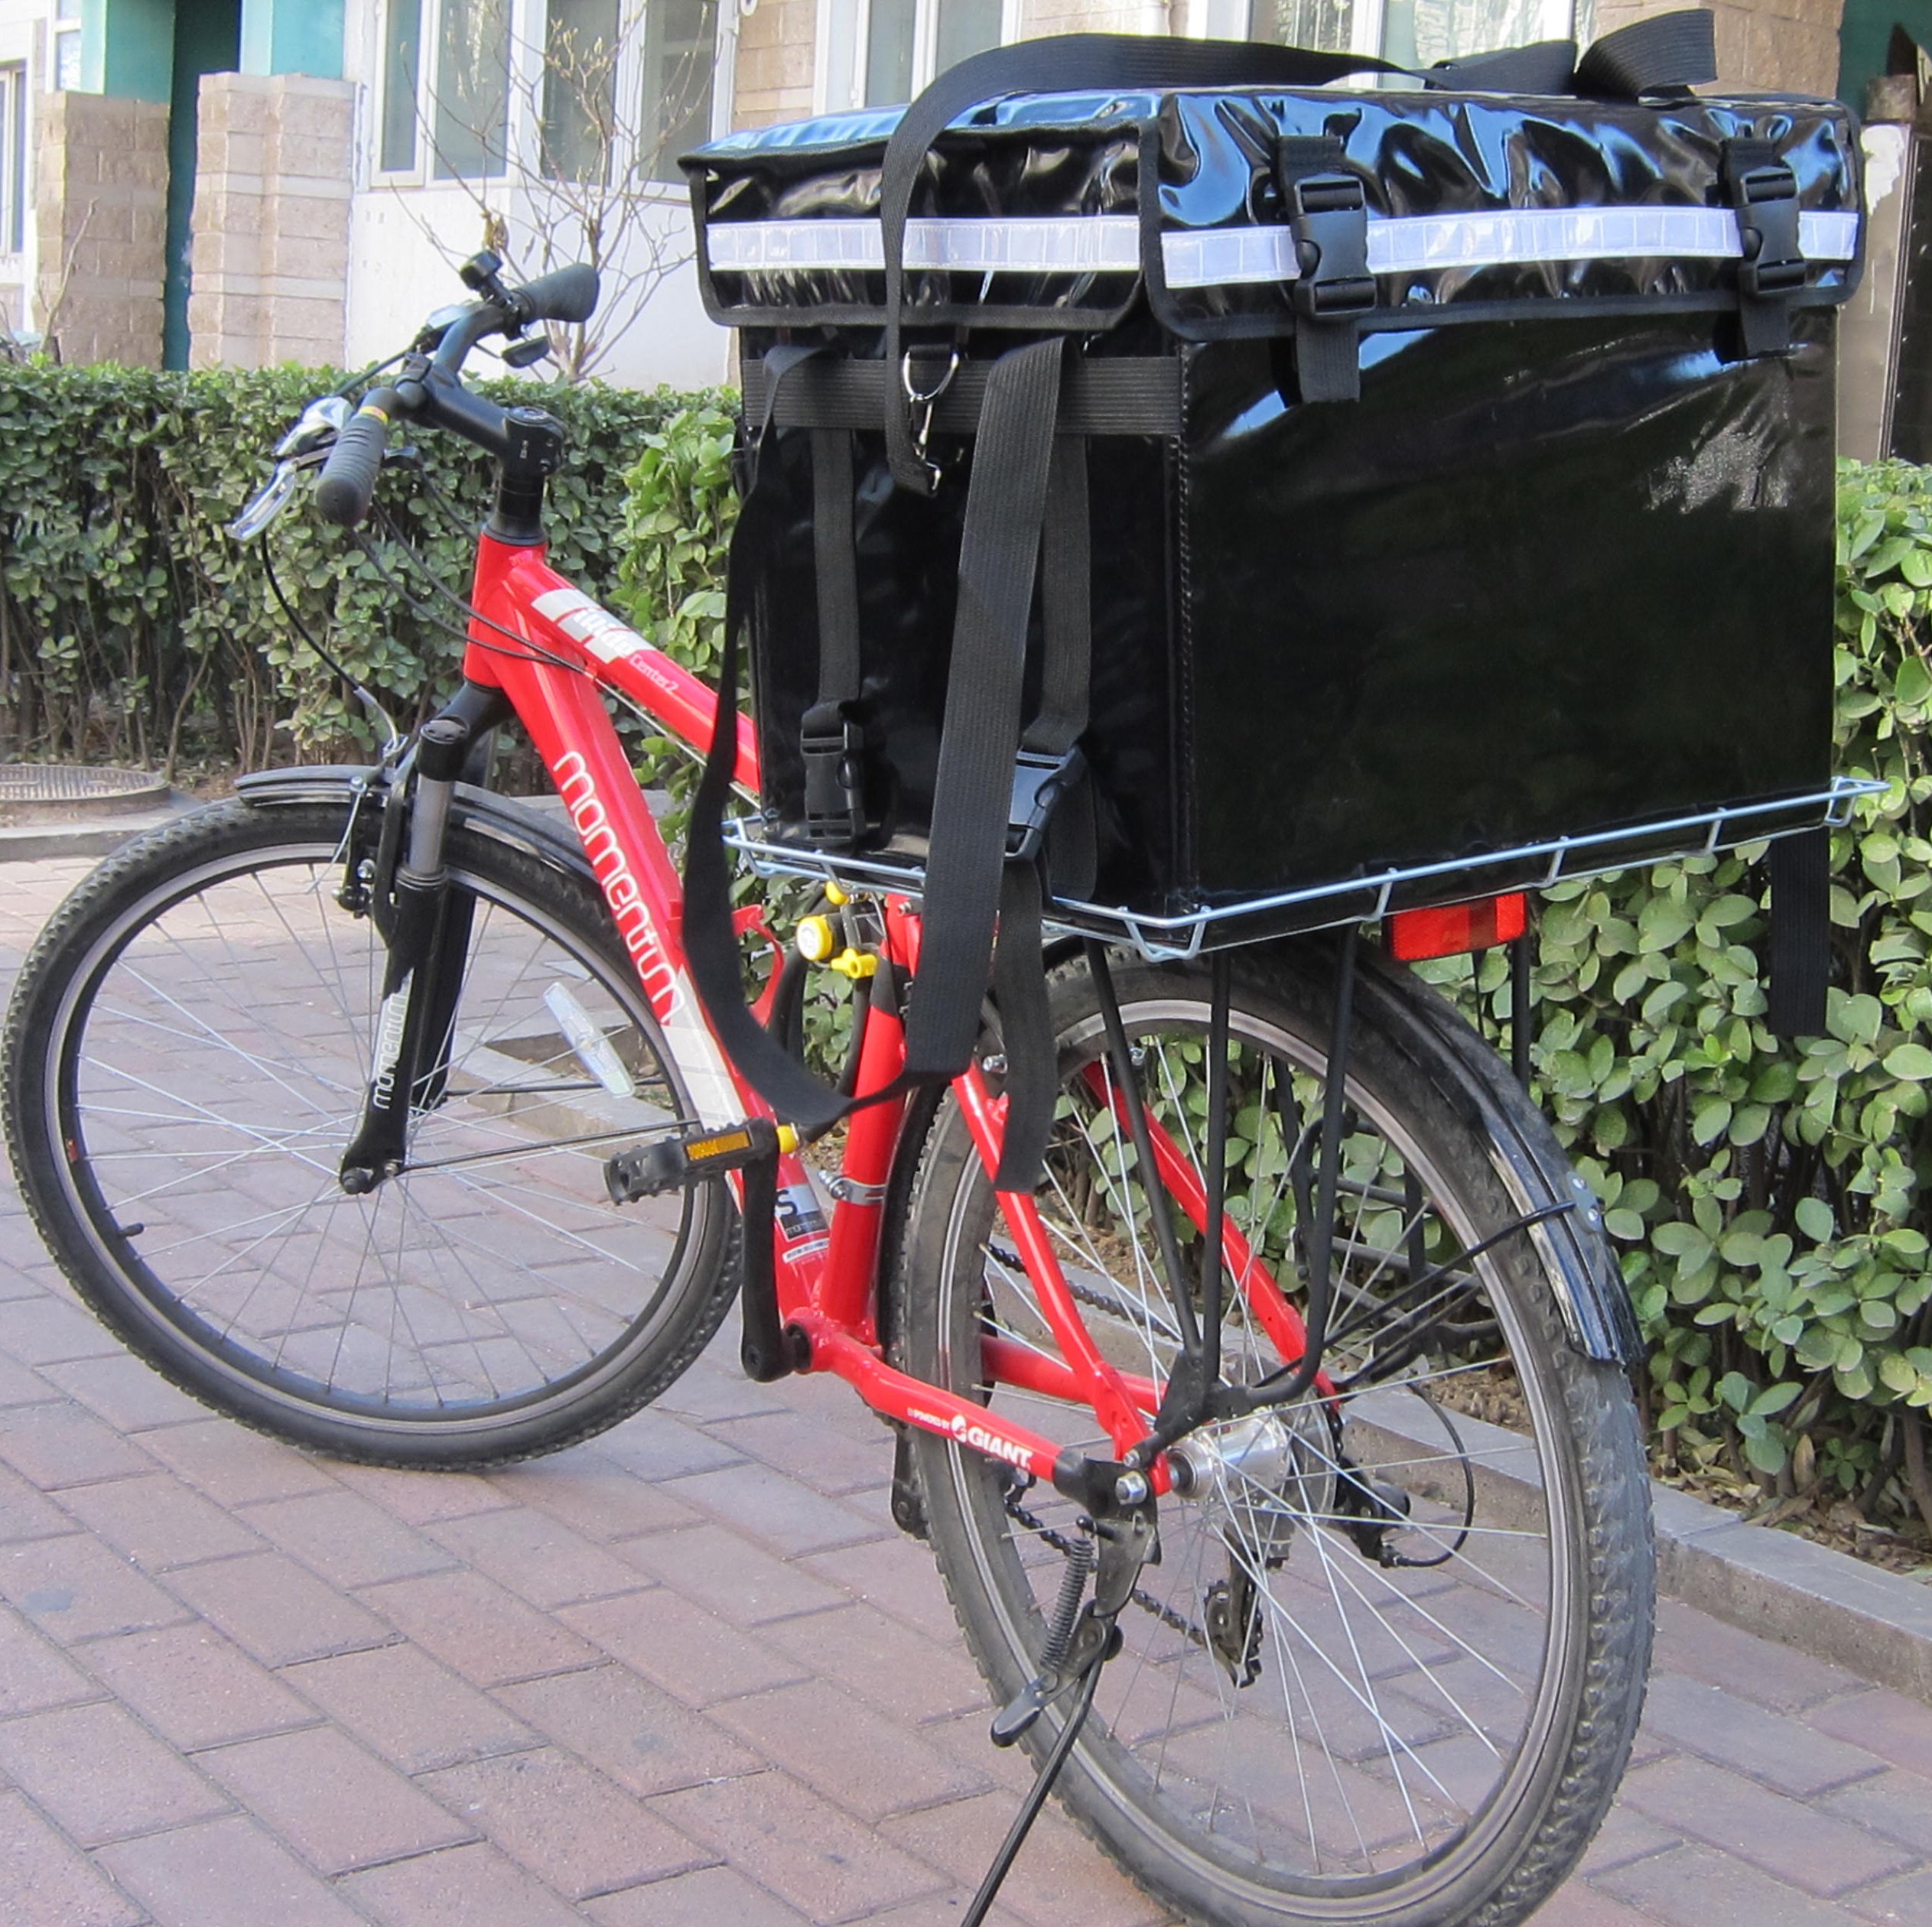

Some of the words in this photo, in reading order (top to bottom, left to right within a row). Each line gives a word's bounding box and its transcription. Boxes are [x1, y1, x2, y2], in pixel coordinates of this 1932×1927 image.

[629, 652, 679, 694] Center2
[553, 751, 685, 1025] momentum
[373, 993, 408, 1110] momentum
[968, 1428, 1033, 1468] GIANT
